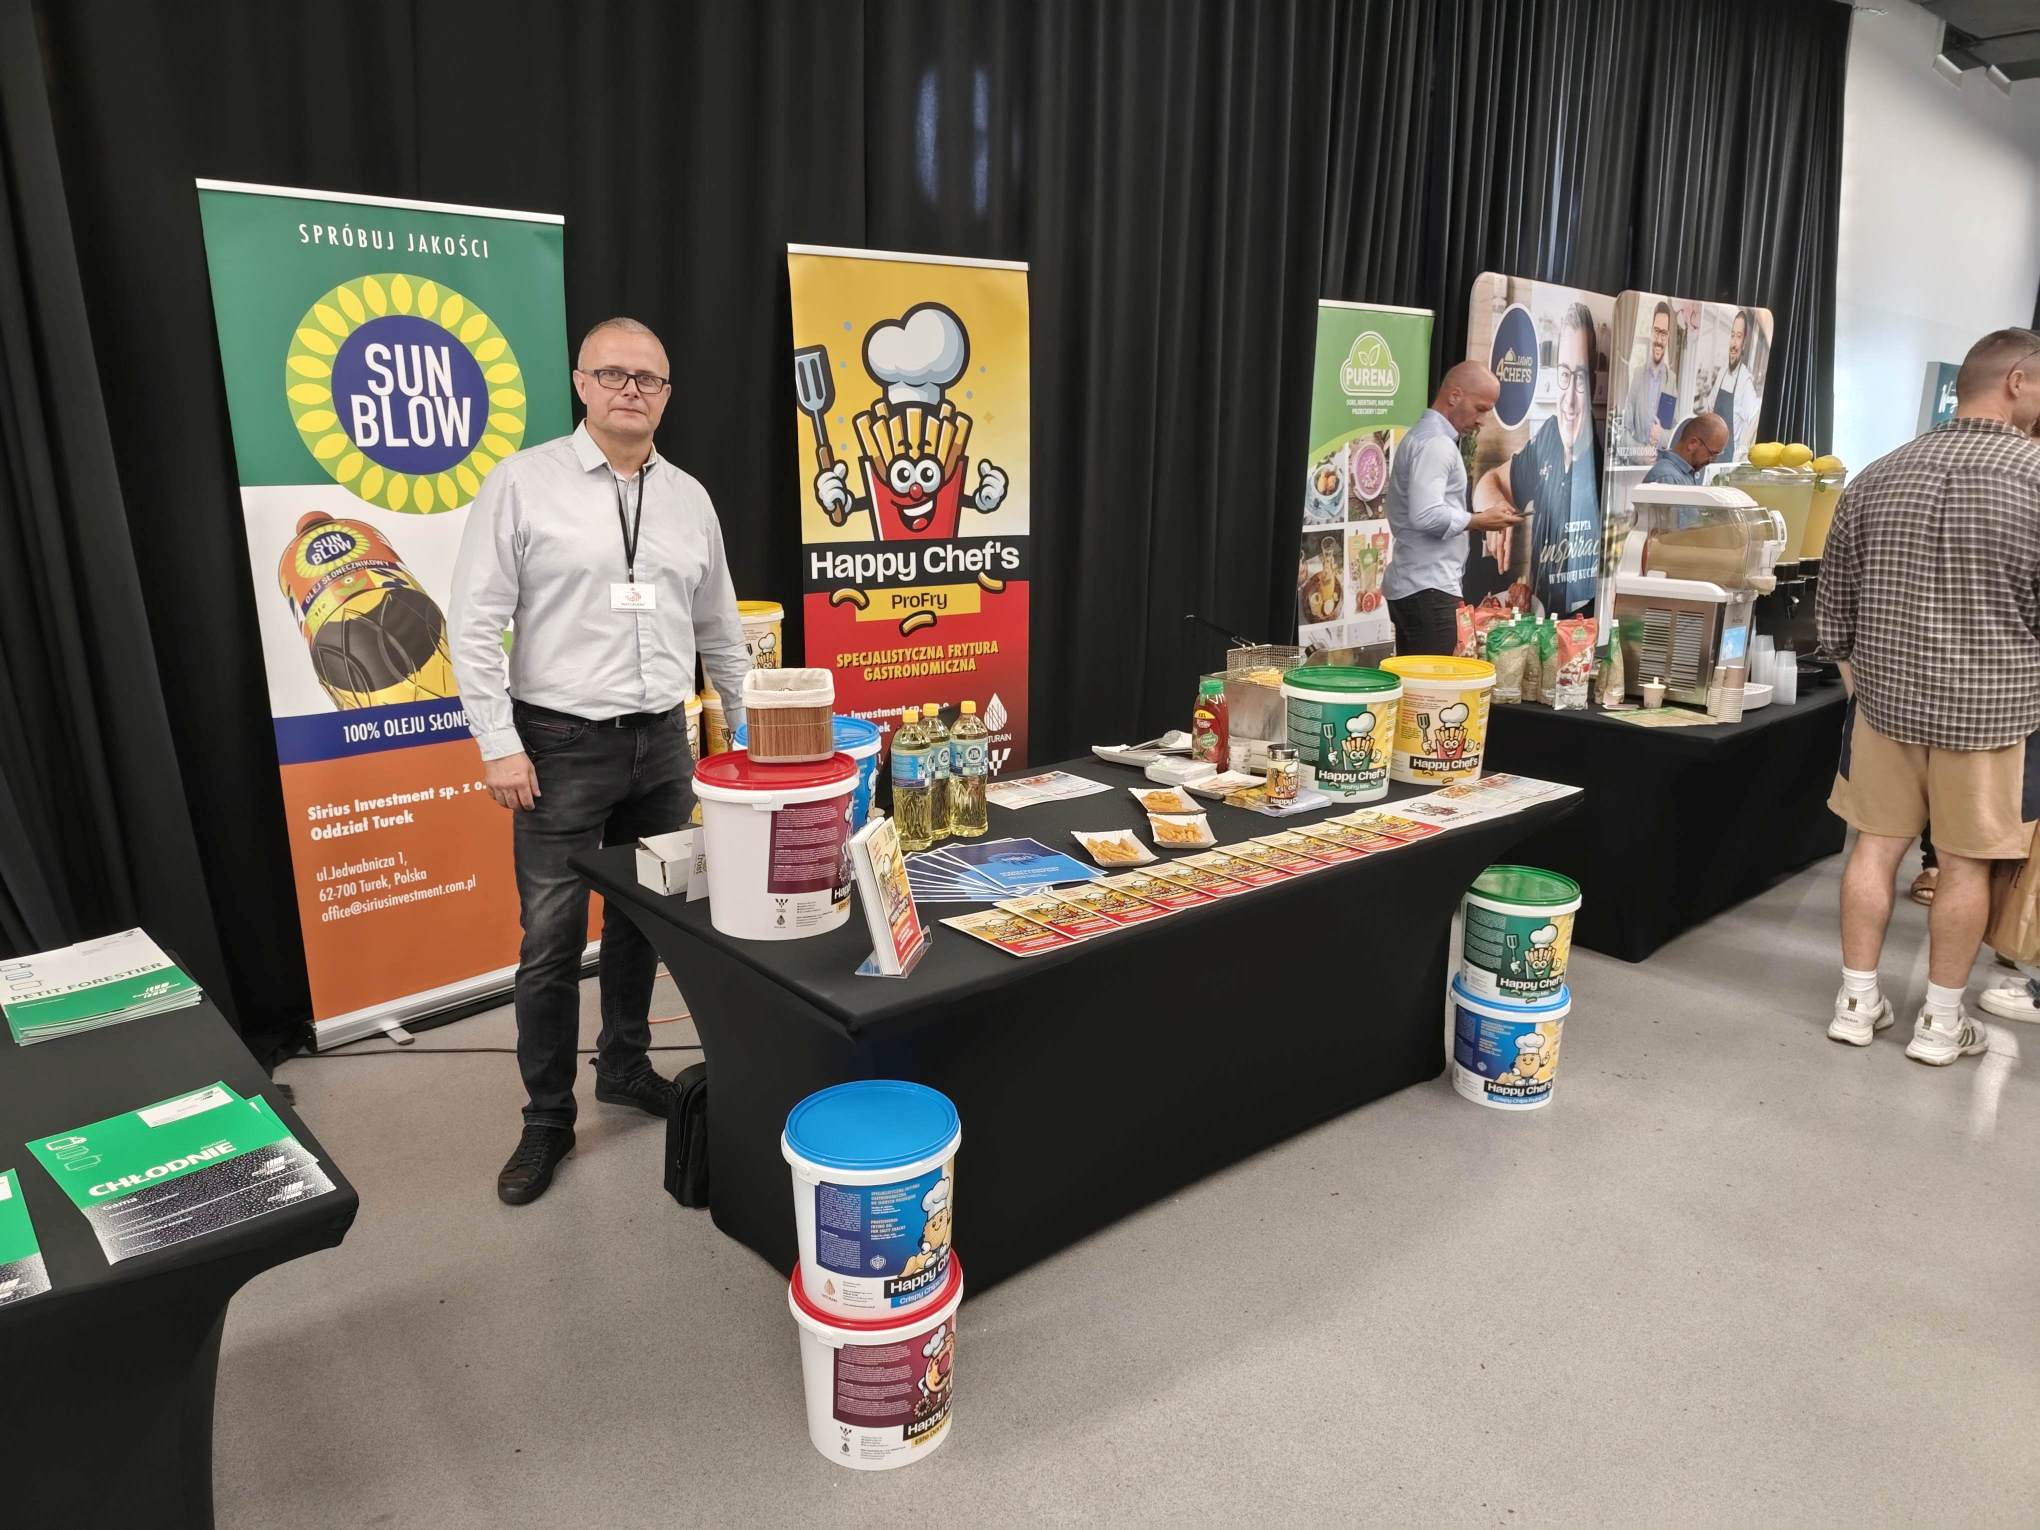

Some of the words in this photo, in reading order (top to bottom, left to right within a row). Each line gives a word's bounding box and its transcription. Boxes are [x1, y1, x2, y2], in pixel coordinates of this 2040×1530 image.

[298, 222, 395, 251] SPRÓBUJ
[407, 232, 490, 260] JAKOŚCI
[363, 342, 454, 398] SUN
[1346, 367, 1394, 387] PURENA
[350, 393, 472, 448] BLOW
[311, 540, 353, 566] BLOW
[312, 533, 344, 553] SUN
[810, 550, 917, 584] Happy
[923, 540, 1020, 573] Chef's
[305, 582, 323, 605] OLEJ
[891, 592, 948, 610] ProFry
[837, 645, 943, 669] SPECJALISTYCZNA
[948, 640, 999, 658] FRYTURA
[863, 660, 976, 682] GASTRONOMICZNA
[850, 704, 906, 721] Investment
[343, 721, 381, 744] 100%
[384, 712, 425, 738] OLEJU
[1319, 770, 1356, 782] Happy
[1358, 768, 1385, 780] Chef's
[1413, 758, 1450, 770] Happy
[1451, 756, 1478, 769] Chef's
[308, 796, 352, 822] Sirius
[354, 787, 435, 812] Investment
[438, 786, 460, 801] sp.
[462, 783, 471, 795] z
[474, 779, 487, 793] o.
[310, 819, 369, 842] Oddział
[371, 810, 414, 831] Turek
[398, 850, 408, 868] 1,
[319, 882, 358, 903] 62-700
[359, 874, 392, 896] Turek,
[394, 867, 428, 888] Polska
[321, 874, 477, 924] office@siriusinvestment.com.pl
[10, 986, 65, 1002] PETIT
[67, 962, 163, 993] FORESTIER
[1500, 977, 1537, 990] Happy
[1488, 1083, 1525, 1096] Happy
[88, 1141, 237, 1197] CHŁODNIE
[102, 1196, 138, 1211] Gama
[890, 1270, 936, 1295] Happy
[899, 1291, 924, 1305] Crispy
[907, 1409, 944, 1436] Happy
